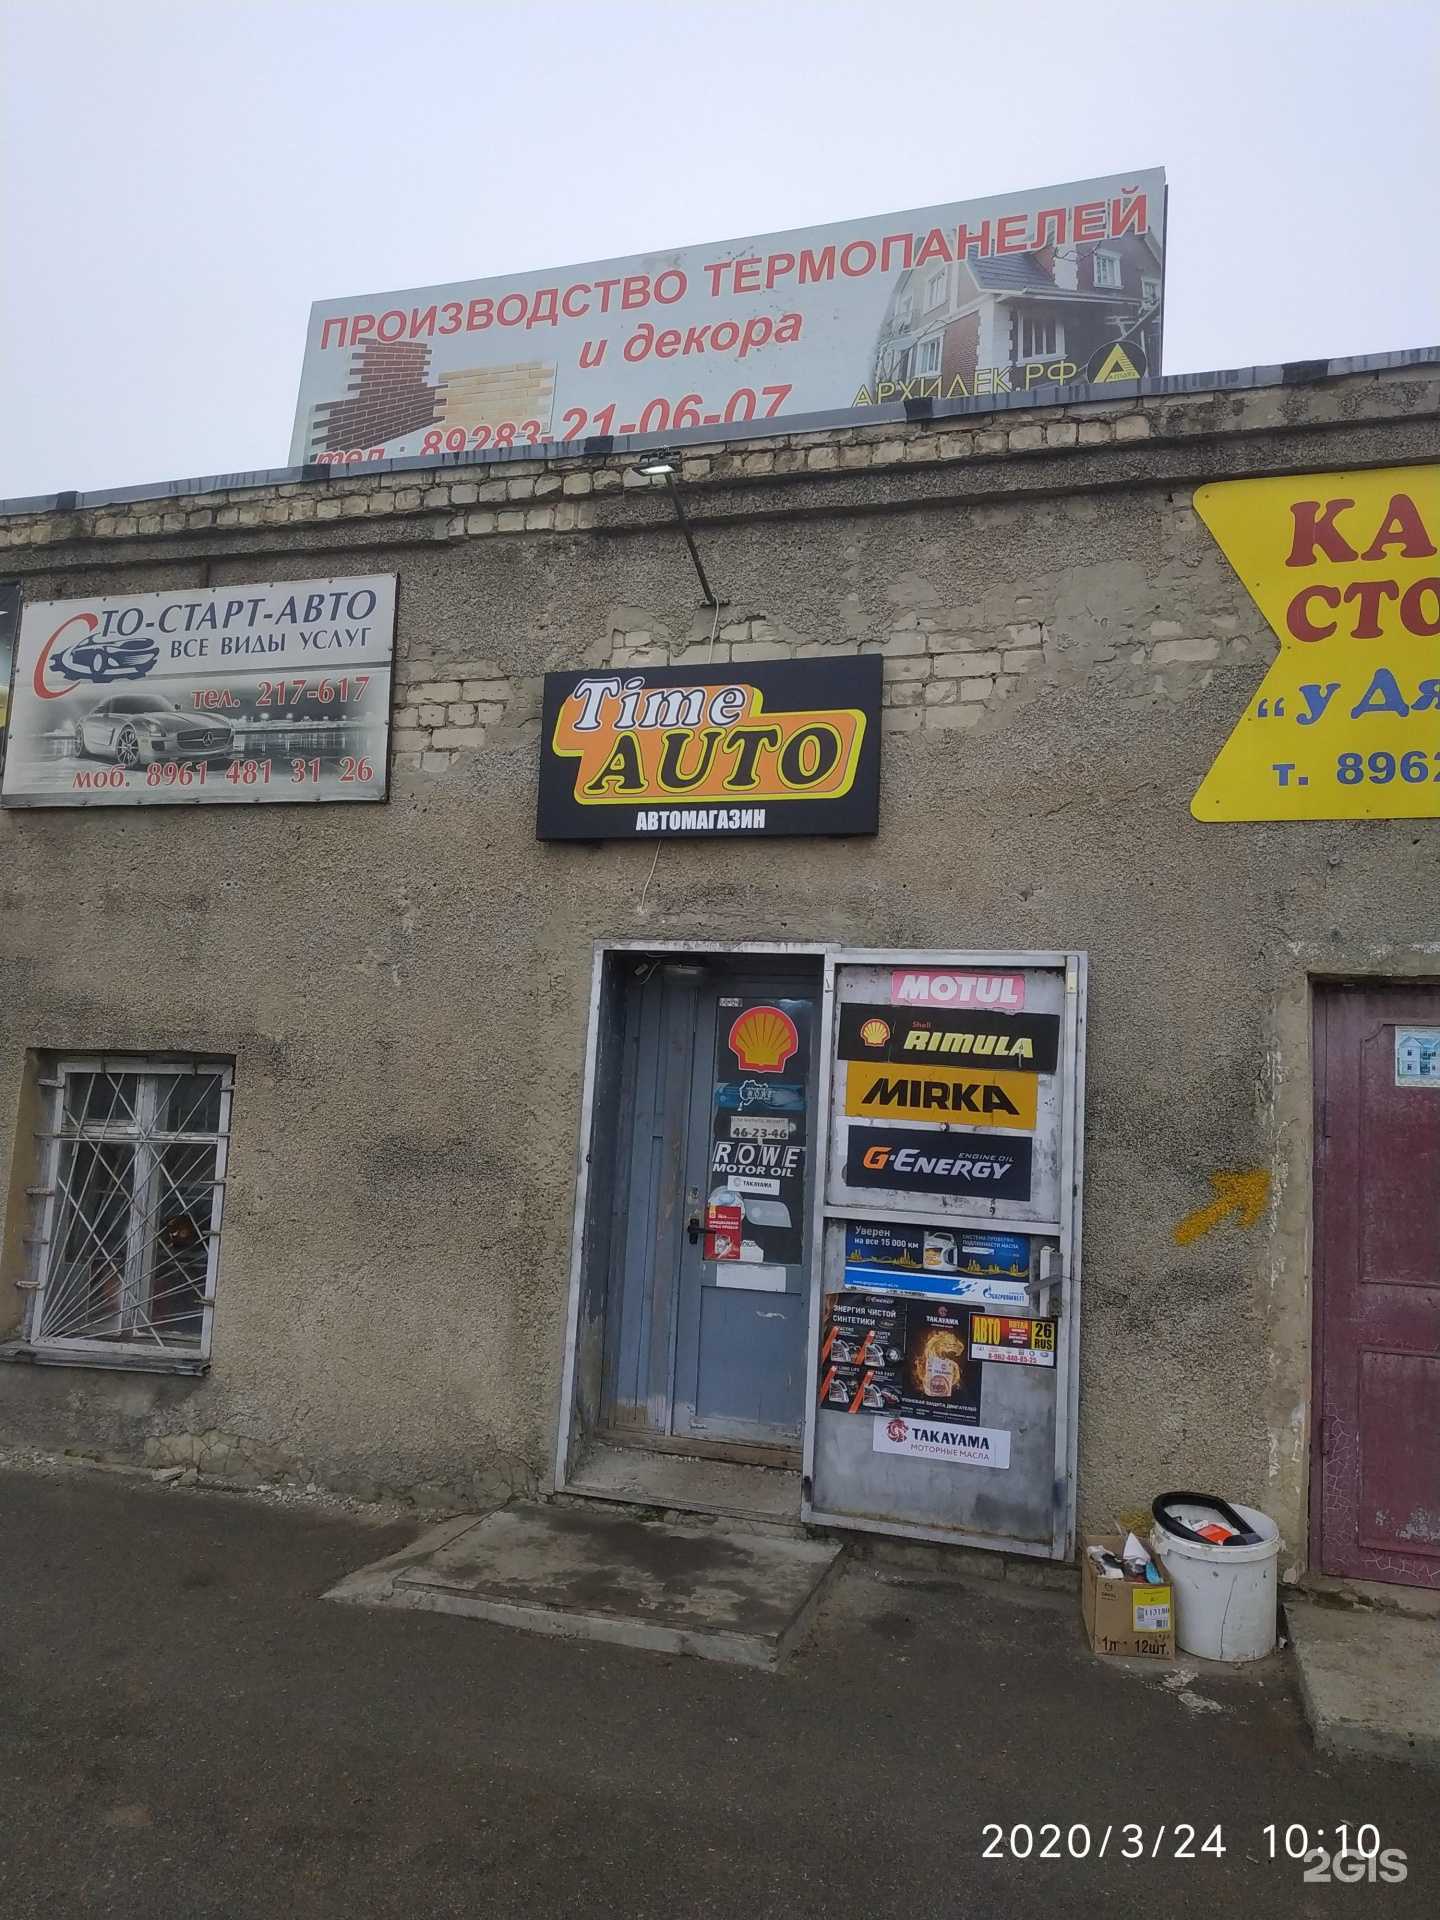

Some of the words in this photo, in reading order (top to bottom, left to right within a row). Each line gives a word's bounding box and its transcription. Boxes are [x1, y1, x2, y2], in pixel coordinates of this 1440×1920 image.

[319, 268, 689, 351] ПРОИЗВОДСТВО
[702, 184, 1149, 298] ТЕРМОПАНЕЛЕЙ
[578, 338, 608, 369] и
[622, 312, 803, 362] декора
[170, 636, 209, 659] ВСЕ
[220, 632, 286, 656] ВИДЫ
[299, 626, 372, 651] УСЛУГ
[191, 686, 241, 710] тел.
[255, 675, 371, 707] 217-617
[571, 676, 747, 733] Time
[583, 723, 843, 796] AUTO
[1272, 763, 1310, 787] т.
[1336, 751, 1440, 785] 896
[72, 762, 131, 789] моб.
[146, 760, 208, 788] 8961
[225, 758, 273, 785] 481
[290, 757, 321, 784] 31
[338, 756, 375, 783] 26
[635, 808, 767, 832] АВТОМАГАЗИН
[897, 974, 1019, 1004] MOTUL
[903, 1030, 1034, 1059] RIMULA
[860, 1077, 1021, 1116] MIRKA
[732, 1127, 788, 1139] 46-23-46
[713, 1143, 801, 1168] ROWE
[957, 1151, 996, 1162] ENGINE
[712, 1162, 767, 1175] MOTOR
[769, 1166, 795, 1177] OIL
[855, 1224, 891, 1238] Уверен
[865, 1238, 879, 1246] все
[881, 1238, 891, 1247] 15
[891, 1239, 907, 1248] 000
[907, 1241, 919, 1249] км
[832, 1315, 876, 1326] СИНТЕТИКИ
[833, 1304, 866, 1315] ЭНЕРГИЯ
[867, 1308, 897, 1318] ЧИСТОЙ
[926, 1315, 960, 1326] TAKAYAMA
[973, 1316, 1001, 1345] АВТО
[1035, 1322, 1052, 1339] 26
[1034, 1338, 1053, 1351] RUS
[912, 1427, 991, 1450] TAKAYAMA
[910, 1443, 959, 1457] МОТОРНЫЕ
[959, 1449, 991, 1461] МАСЛА
